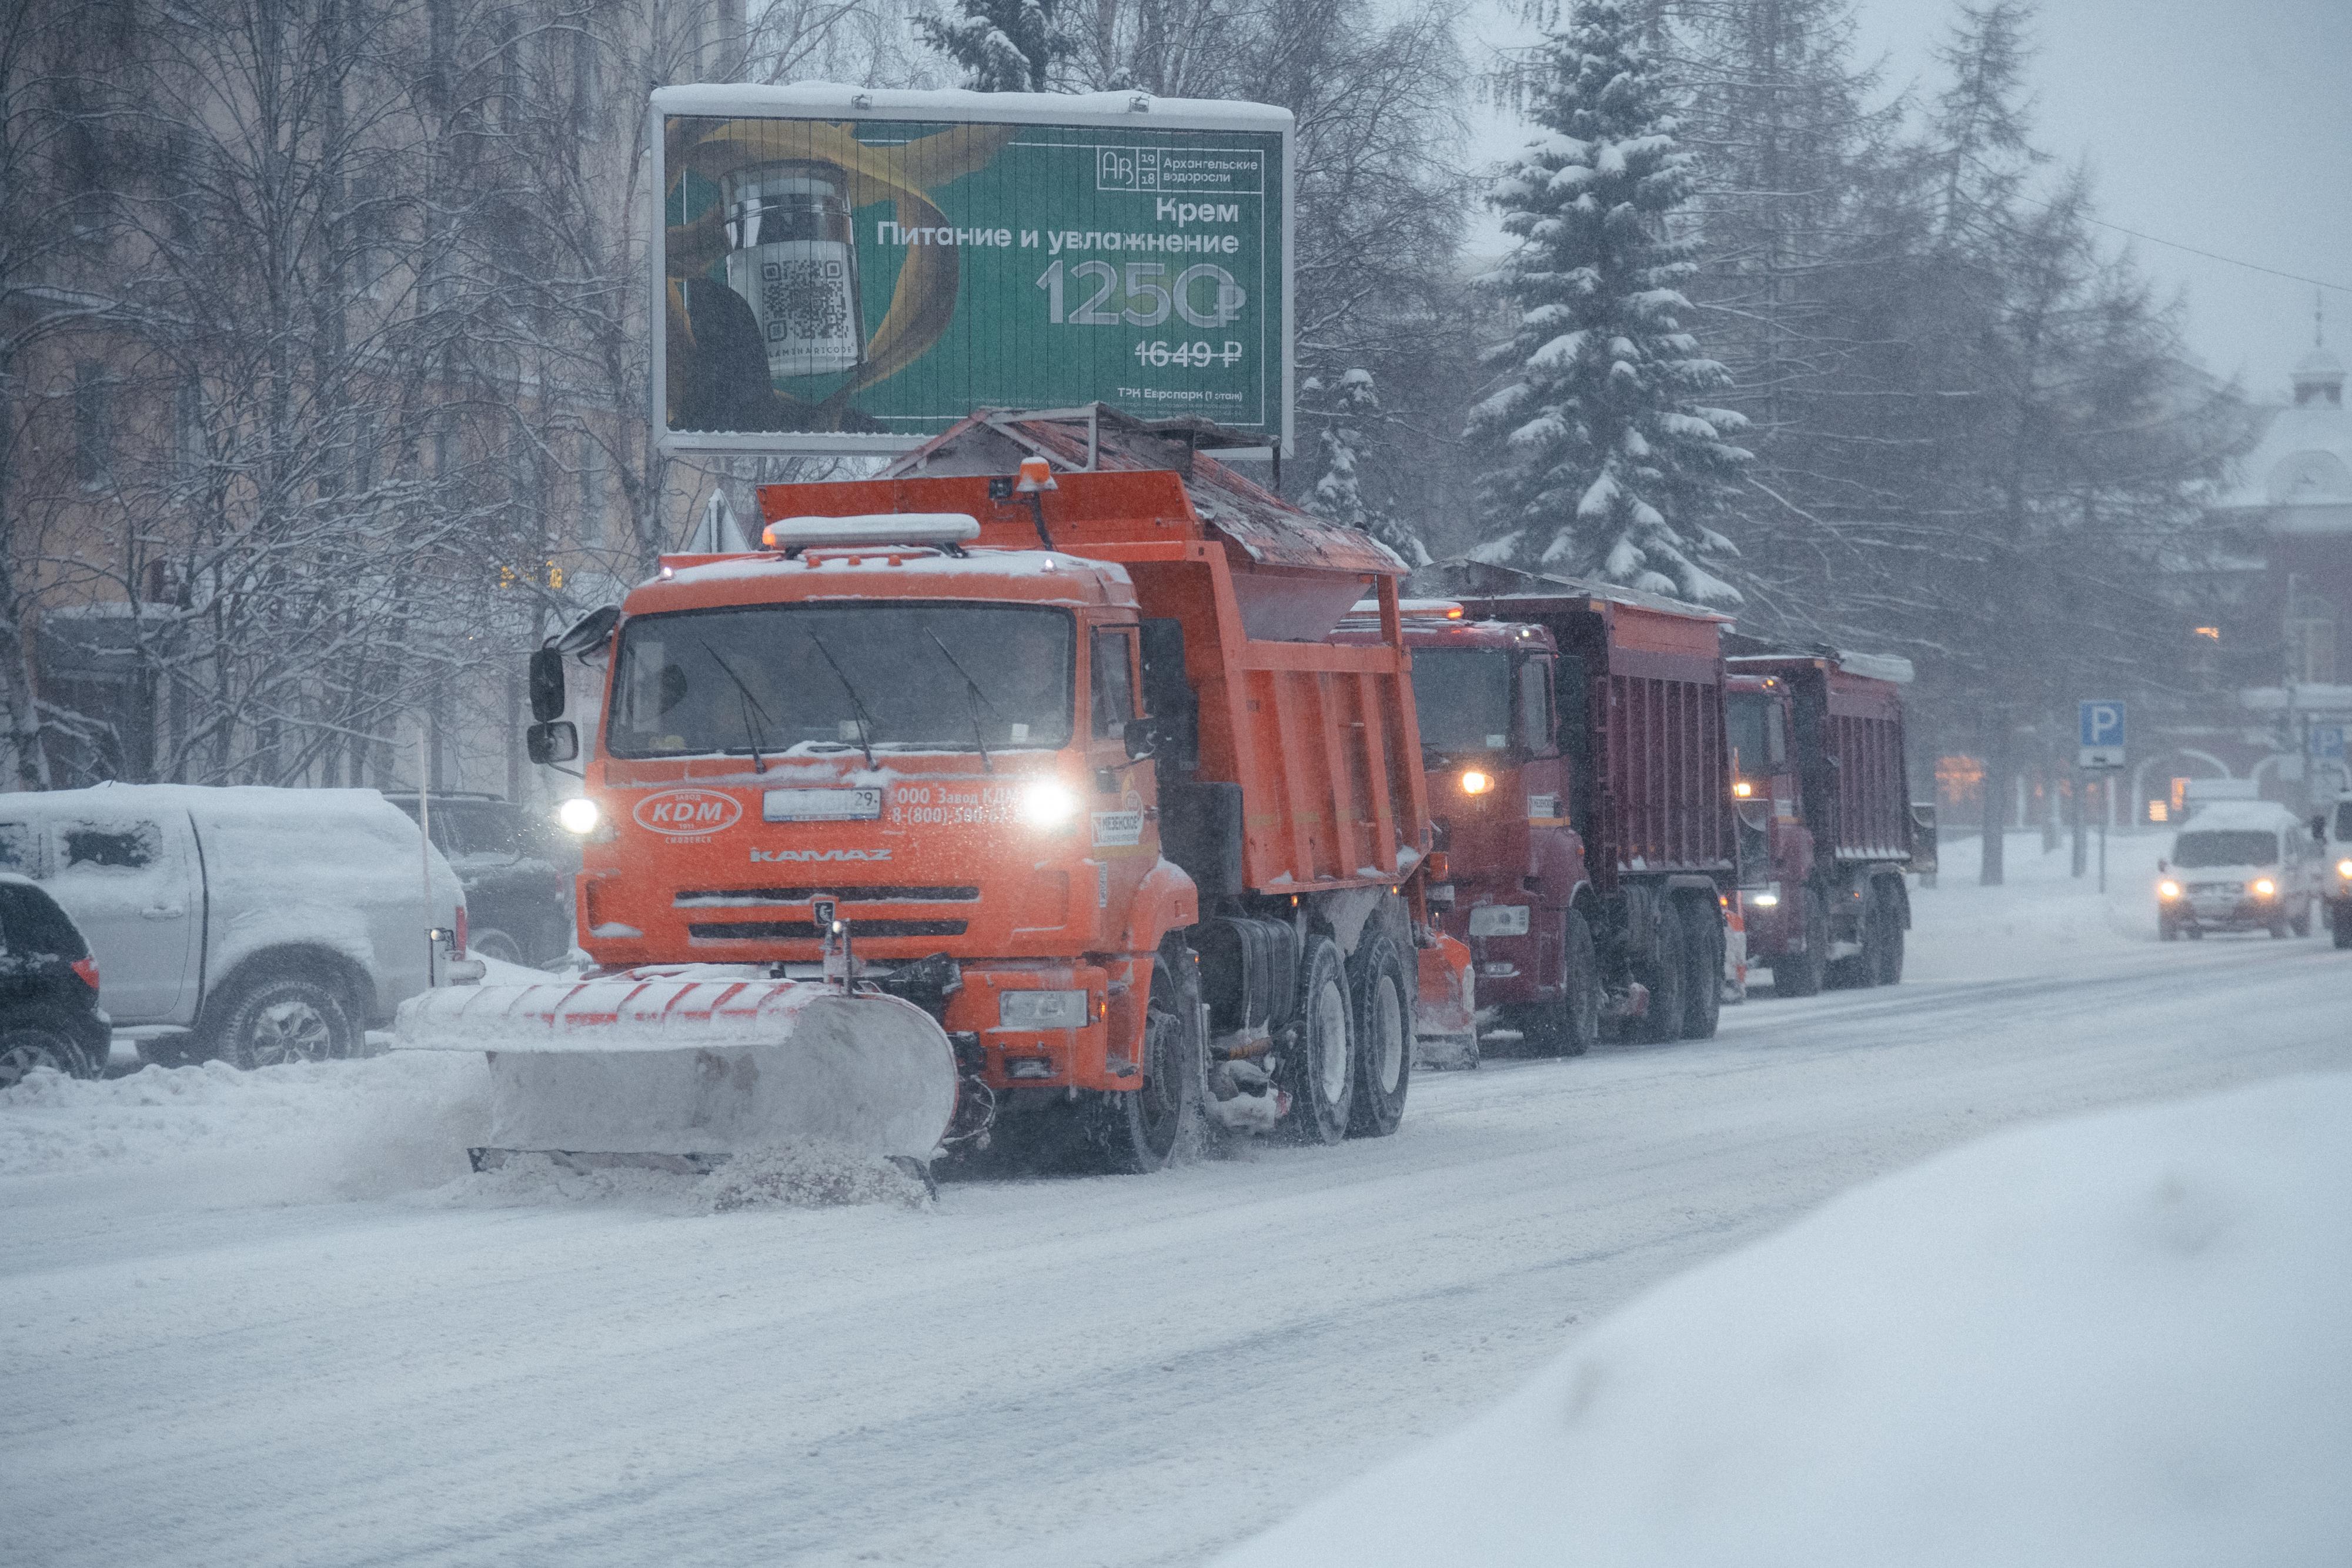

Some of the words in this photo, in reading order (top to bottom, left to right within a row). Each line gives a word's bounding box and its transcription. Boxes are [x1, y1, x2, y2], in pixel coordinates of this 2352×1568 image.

[1141, 154, 1155, 164] 19
[1163, 157, 1258, 171] Архангельские
[1141, 173, 1155, 184] 18
[1163, 172, 1231, 183] водоросли
[1157, 197, 1238, 228] Крем
[877, 221, 1013, 247] Питание
[1021, 230, 1038, 248] и
[1047, 230, 1240, 255] увлажнение
[1135, 340, 1212, 367] 1649
[1117, 387, 1141, 398] ТРК
[1144, 389, 1204, 401] Европарк
[2092, 706, 2117, 742] P
[854, 792, 873, 806] 29
[652, 802, 723, 822] KDM
[665, 836, 712, 844] СМОЛЕНСК
[750, 848, 893, 862] KAMAZ
